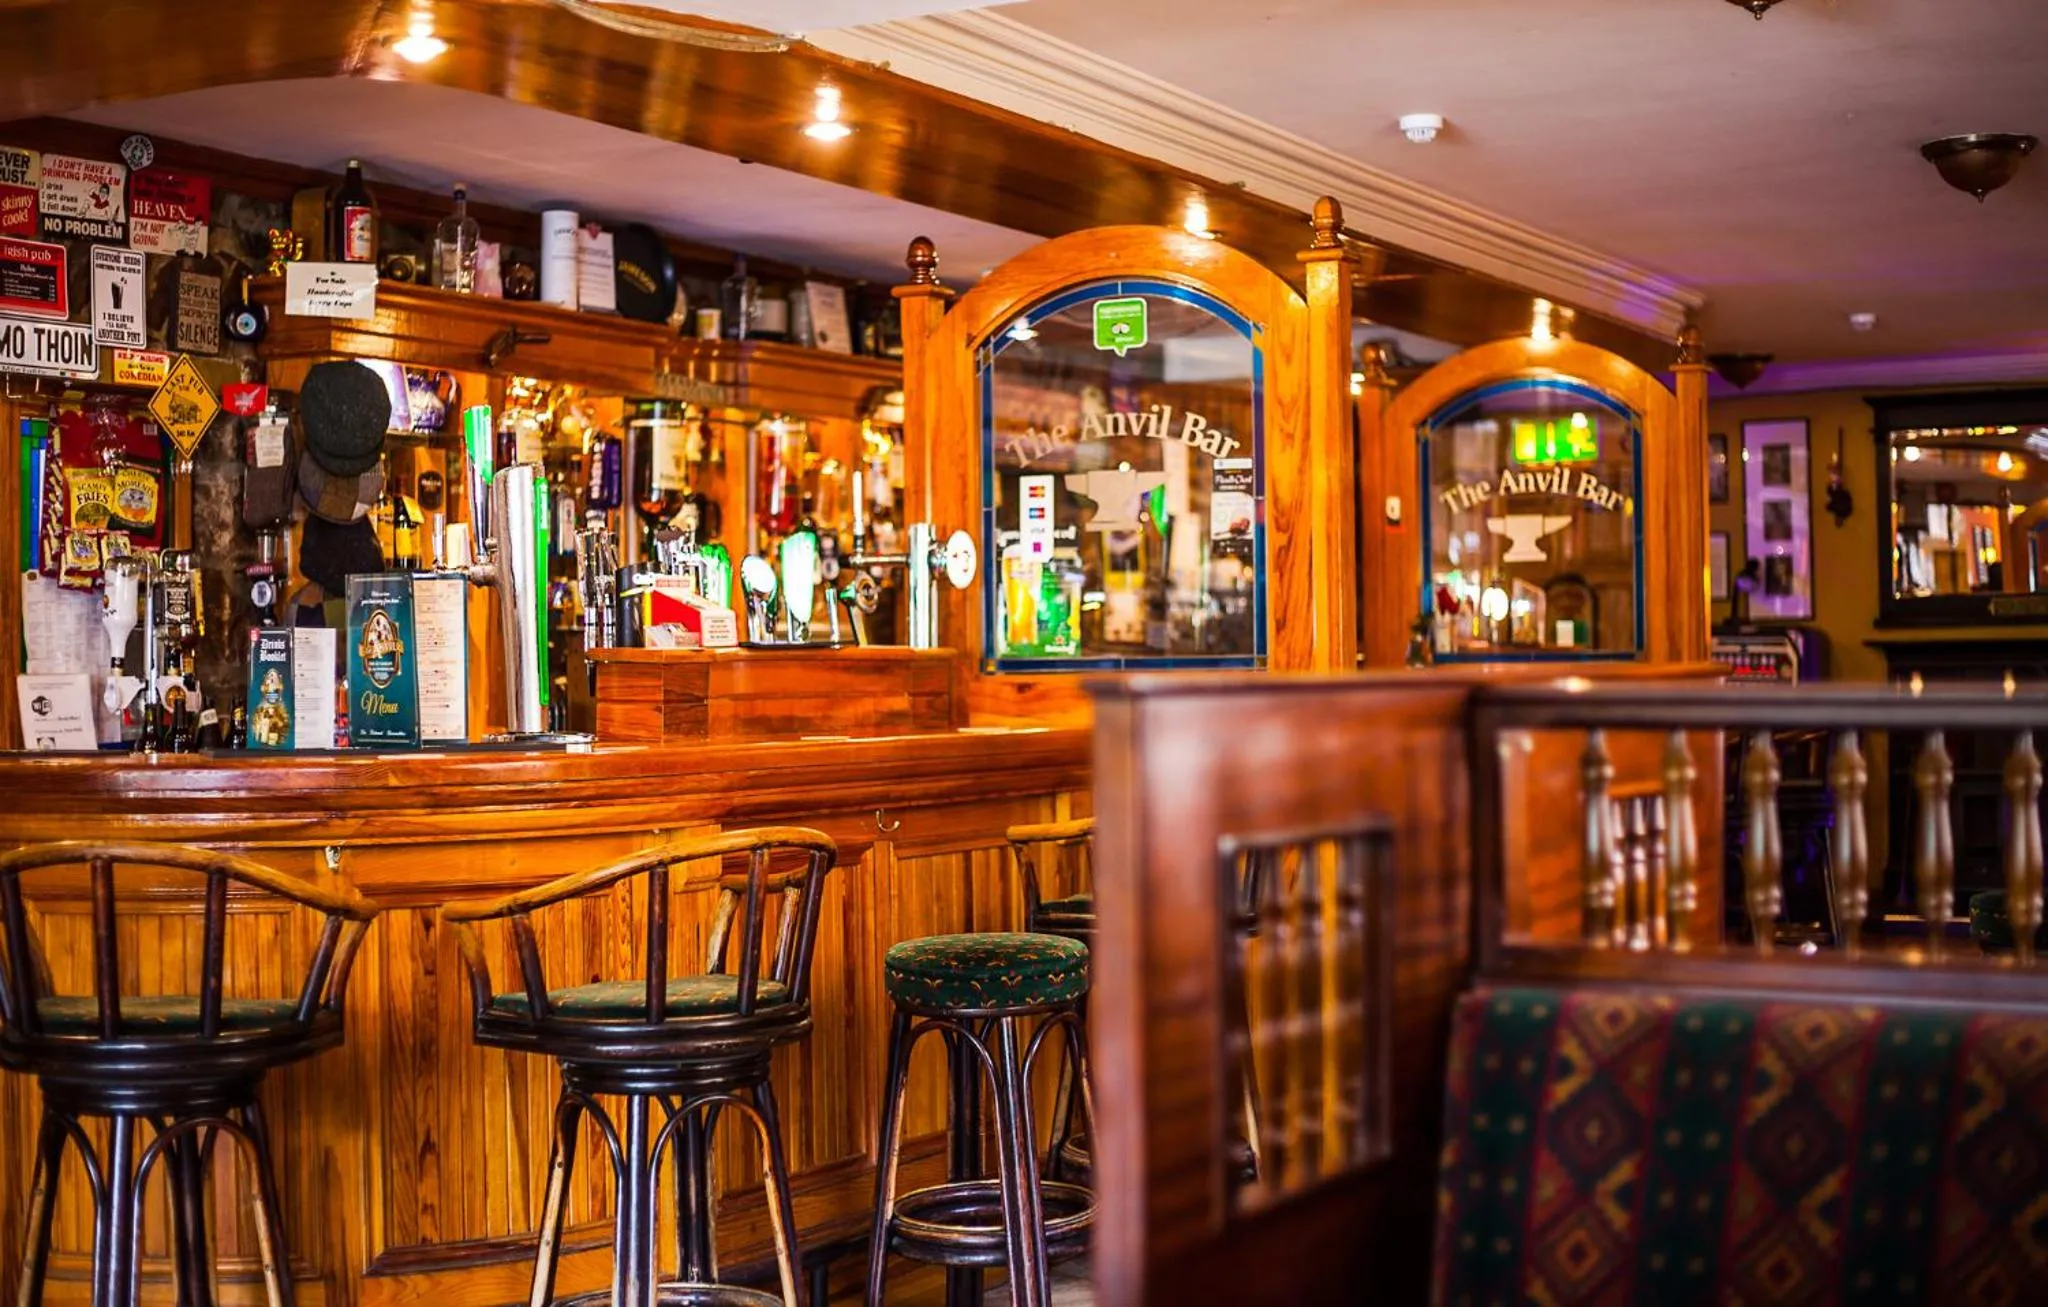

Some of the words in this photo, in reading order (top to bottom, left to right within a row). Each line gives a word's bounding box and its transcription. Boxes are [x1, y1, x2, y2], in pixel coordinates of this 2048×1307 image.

[57, 160, 82, 169] DON'T
[85, 163, 105, 173] HAVE
[0, 167, 36, 186] UST...
[42, 168, 79, 181] DRINKING
[83, 174, 121, 186] PROBLEM
[2, 192, 34, 211] skinny
[44, 218, 62, 231] NO
[65, 220, 123, 239] PROBLEM
[150, 223, 165, 234] NOT
[134, 235, 159, 246] GOING
[107, 313, 134, 323] BELIEVE
[179, 321, 218, 346] SILENCE
[34, 327, 92, 366] THOIN
[119, 370, 164, 382] COMEDIAN
[1005, 424, 1069, 468] The
[1081, 404, 1172, 441] Anvil
[1181, 411, 1241, 458] Bar
[76, 491, 109, 505] FRIES
[1439, 480, 1491, 515] The
[1499, 466, 1570, 496] Anvil
[1577, 472, 1625, 511] Bar
[261, 638, 285, 650] Drinks
[361, 690, 398, 716] Menu
